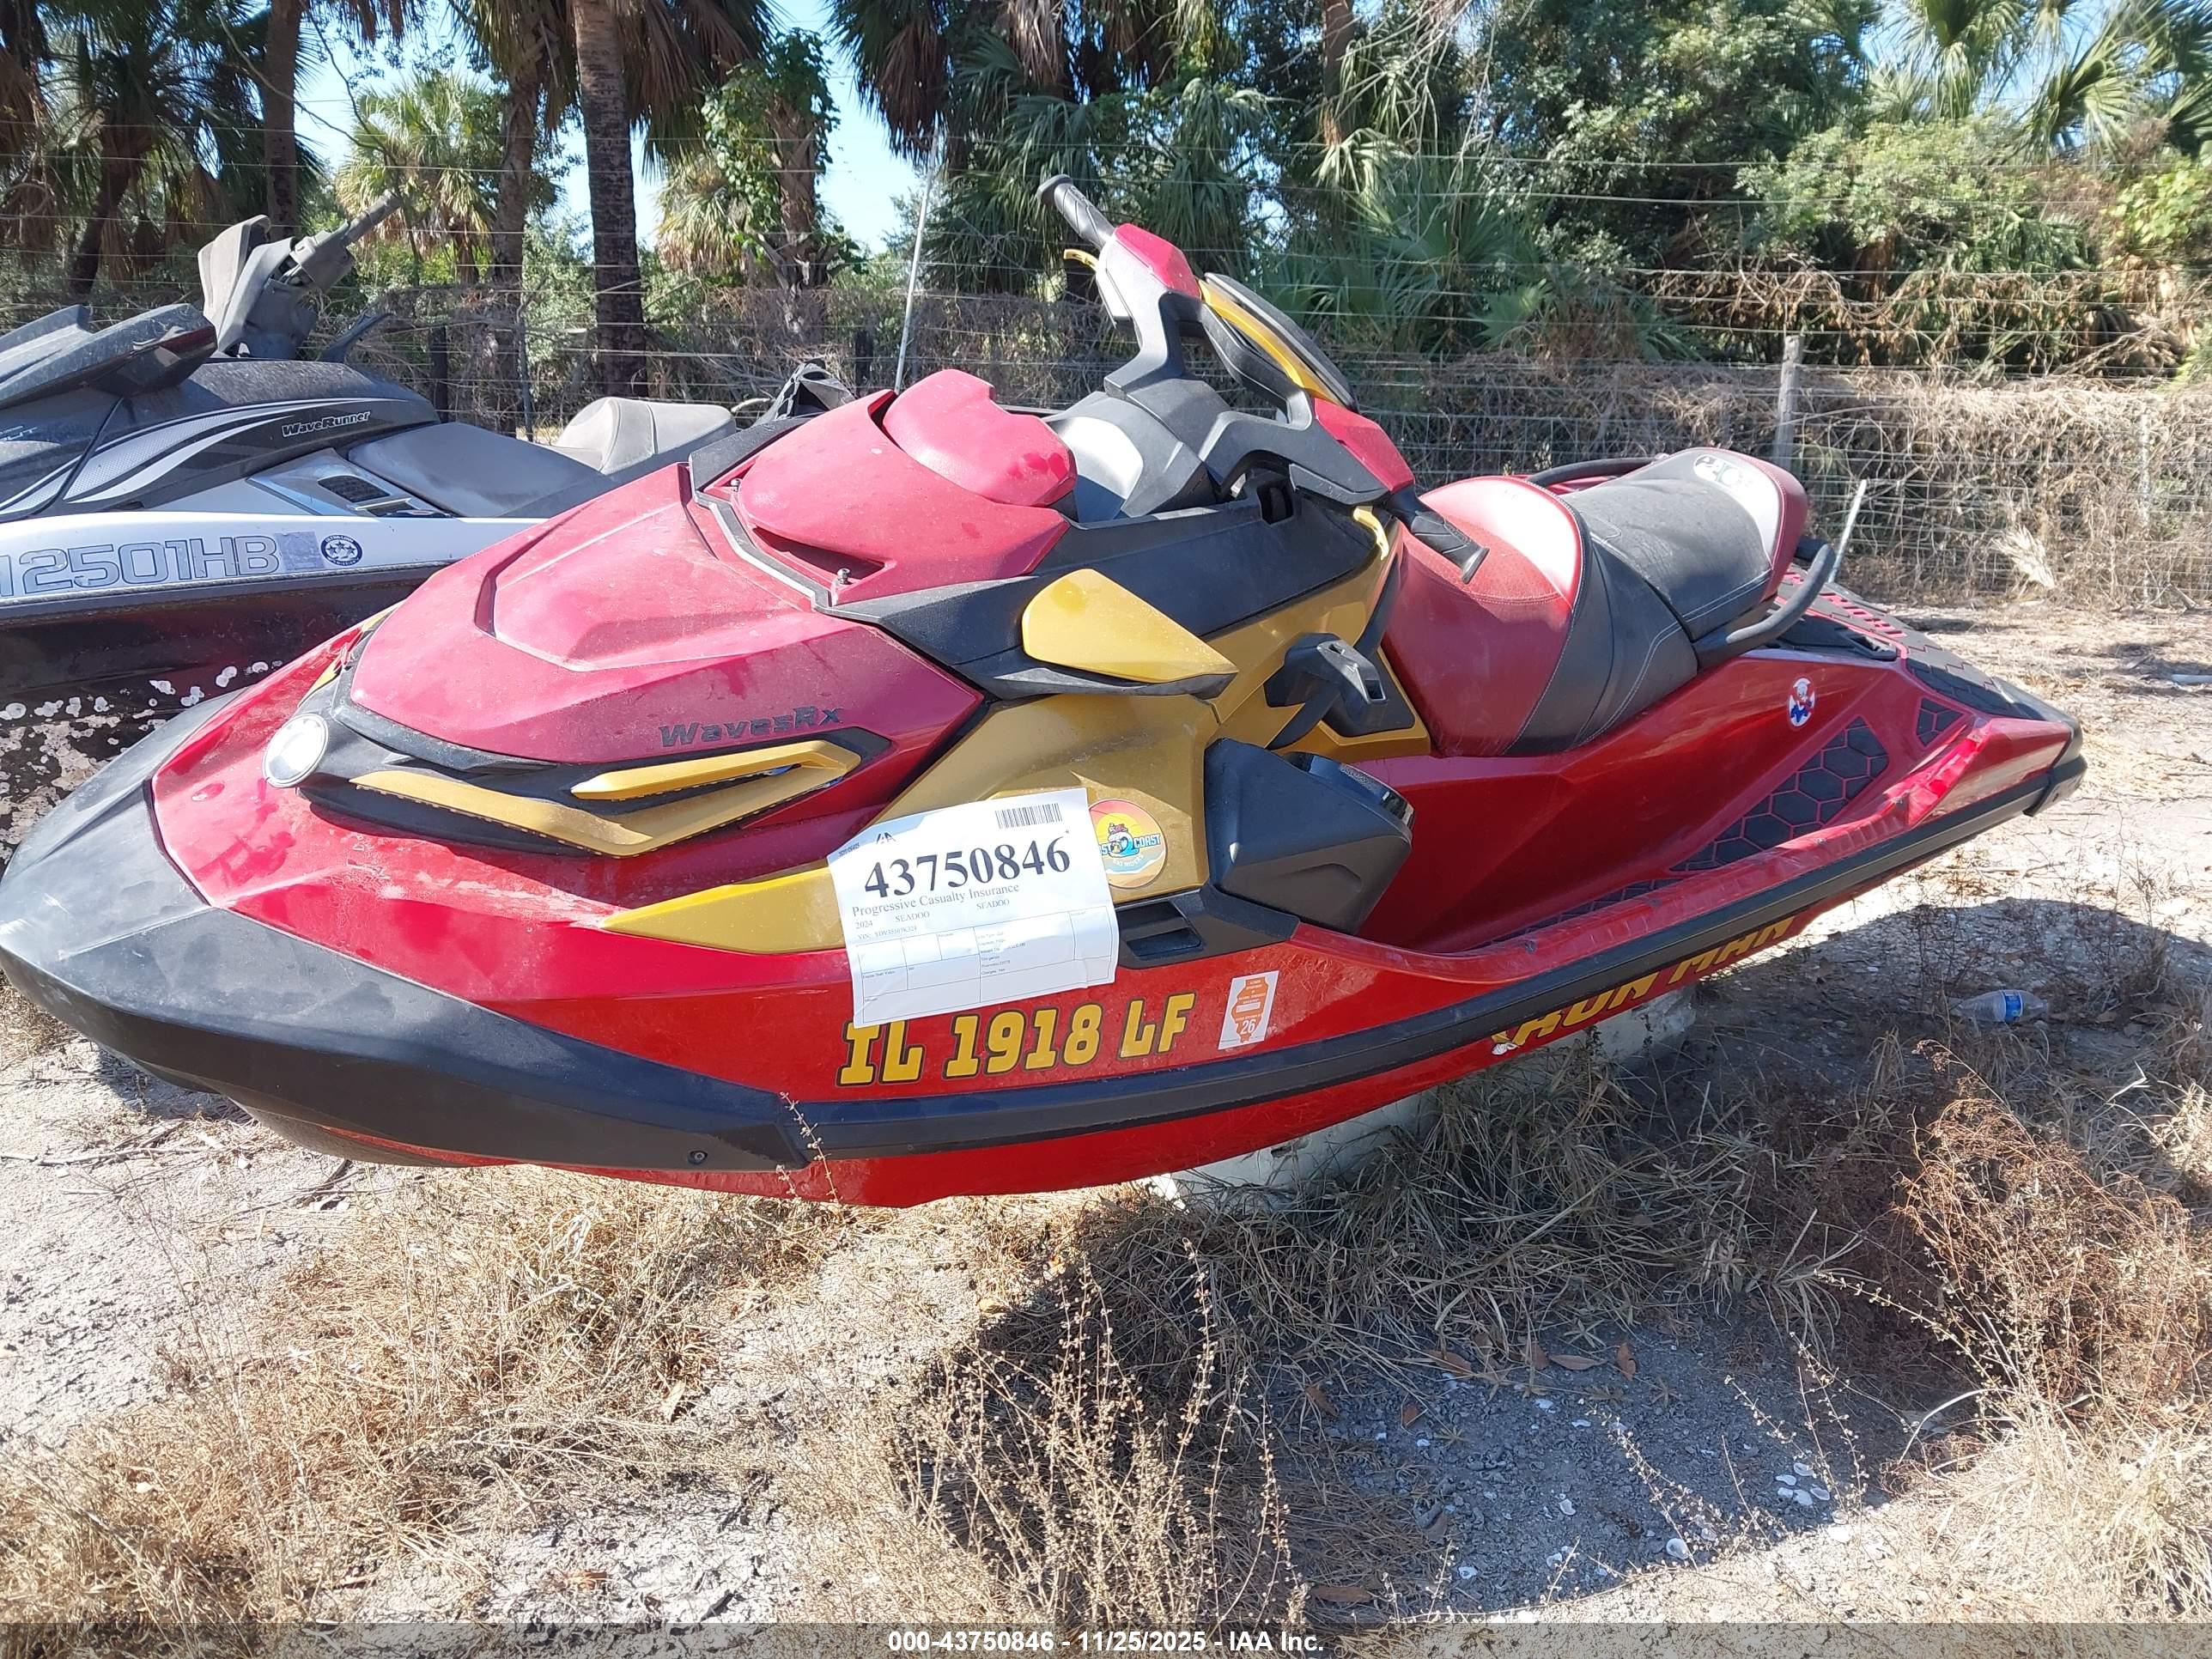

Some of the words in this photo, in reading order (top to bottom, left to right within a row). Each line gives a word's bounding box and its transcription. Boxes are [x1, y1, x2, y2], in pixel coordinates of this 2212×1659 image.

[282, 411, 371, 437] WaveRunner
[659, 706, 844, 748] WavesRx
[1133, 834, 1161, 849] COAST
[864, 836, 1071, 898] 43750846
[853, 898, 917, 917] Progressive
[919, 890, 966, 906] Casualty
[969, 884, 1020, 900] Insurance
[855, 921, 873, 930] 2024
[895, 911, 931, 923] SEADOO
[976, 899, 1010, 910] SEADOO
[837, 1020, 924, 1085] IL
[944, 1003, 1104, 1079] 1918
[1119, 992, 1196, 1059] LF
[1240, 1018, 1256, 1035] 26
